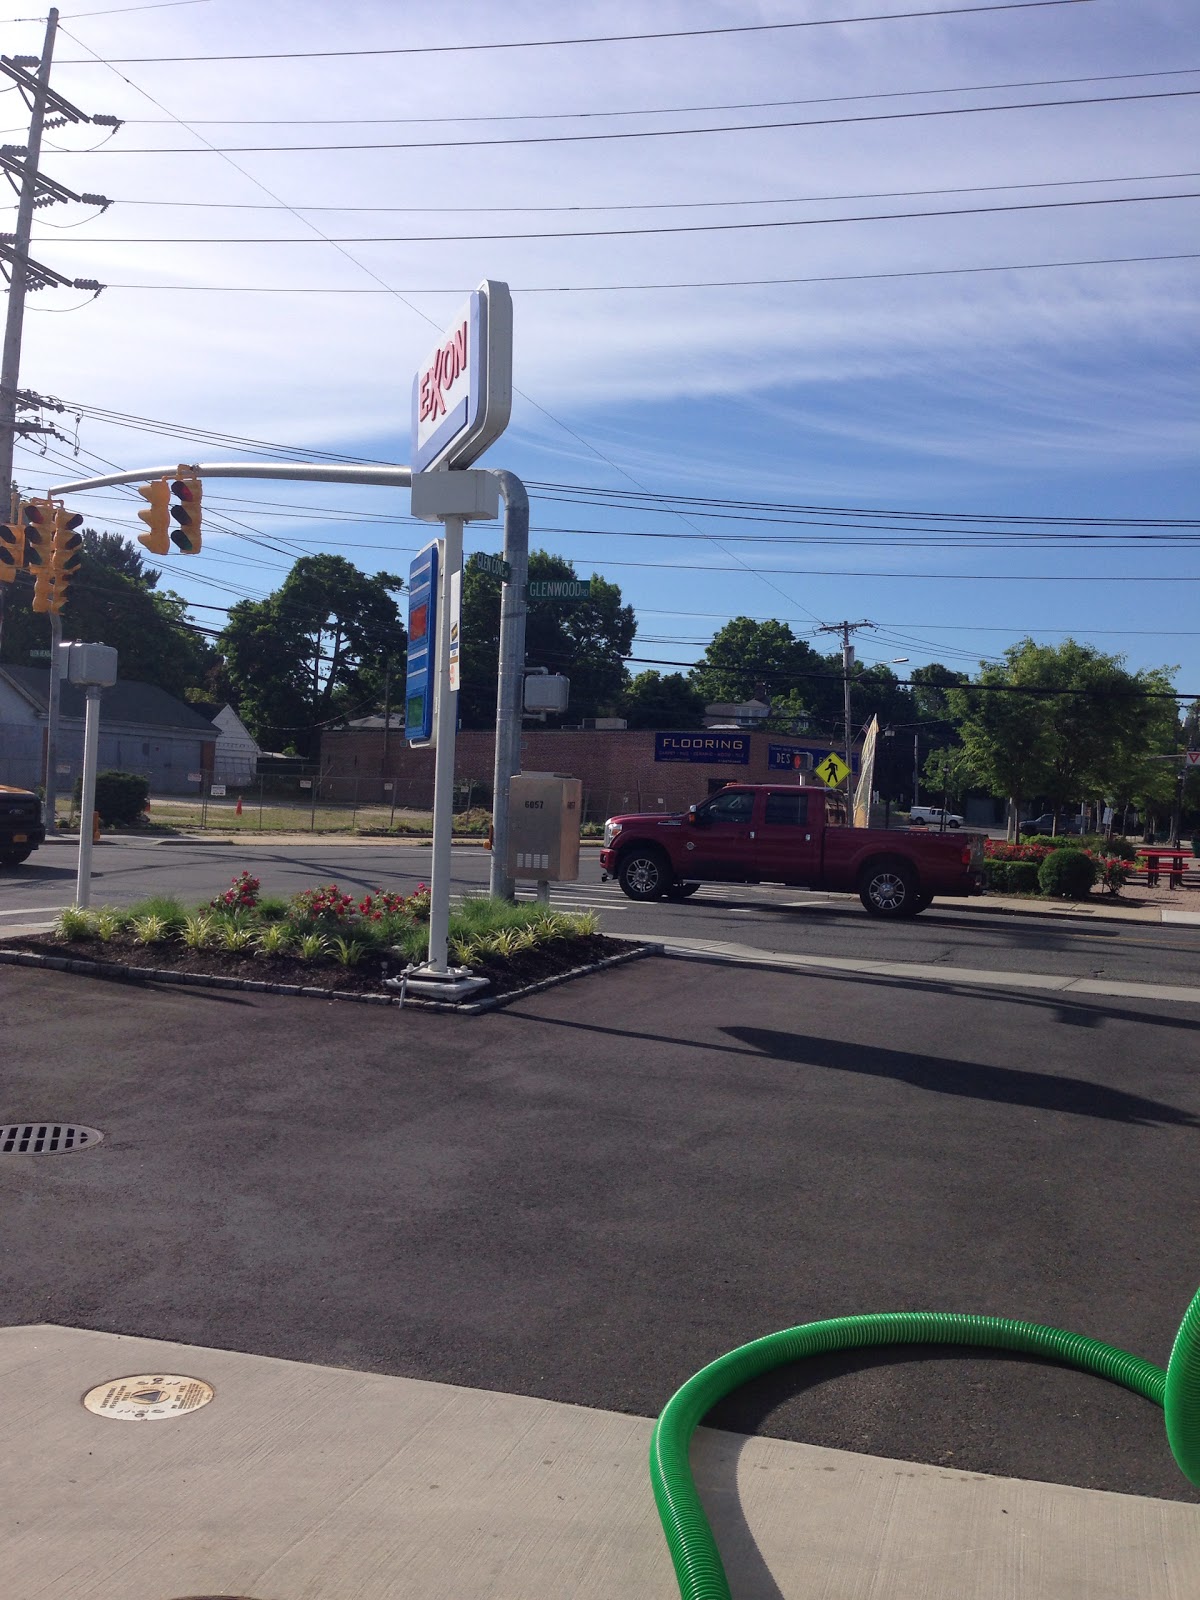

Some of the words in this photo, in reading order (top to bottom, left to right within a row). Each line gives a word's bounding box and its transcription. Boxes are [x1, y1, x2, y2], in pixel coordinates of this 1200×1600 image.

[420, 320, 468, 423] EXXON
[477, 553, 491, 572] GLEN
[491, 558, 505, 577] COVE
[529, 581, 581, 597] GLENWOOD
[663, 738, 743, 750] FLOORING
[776, 752, 791, 764] DES
[524, 800, 544, 809] 6057
